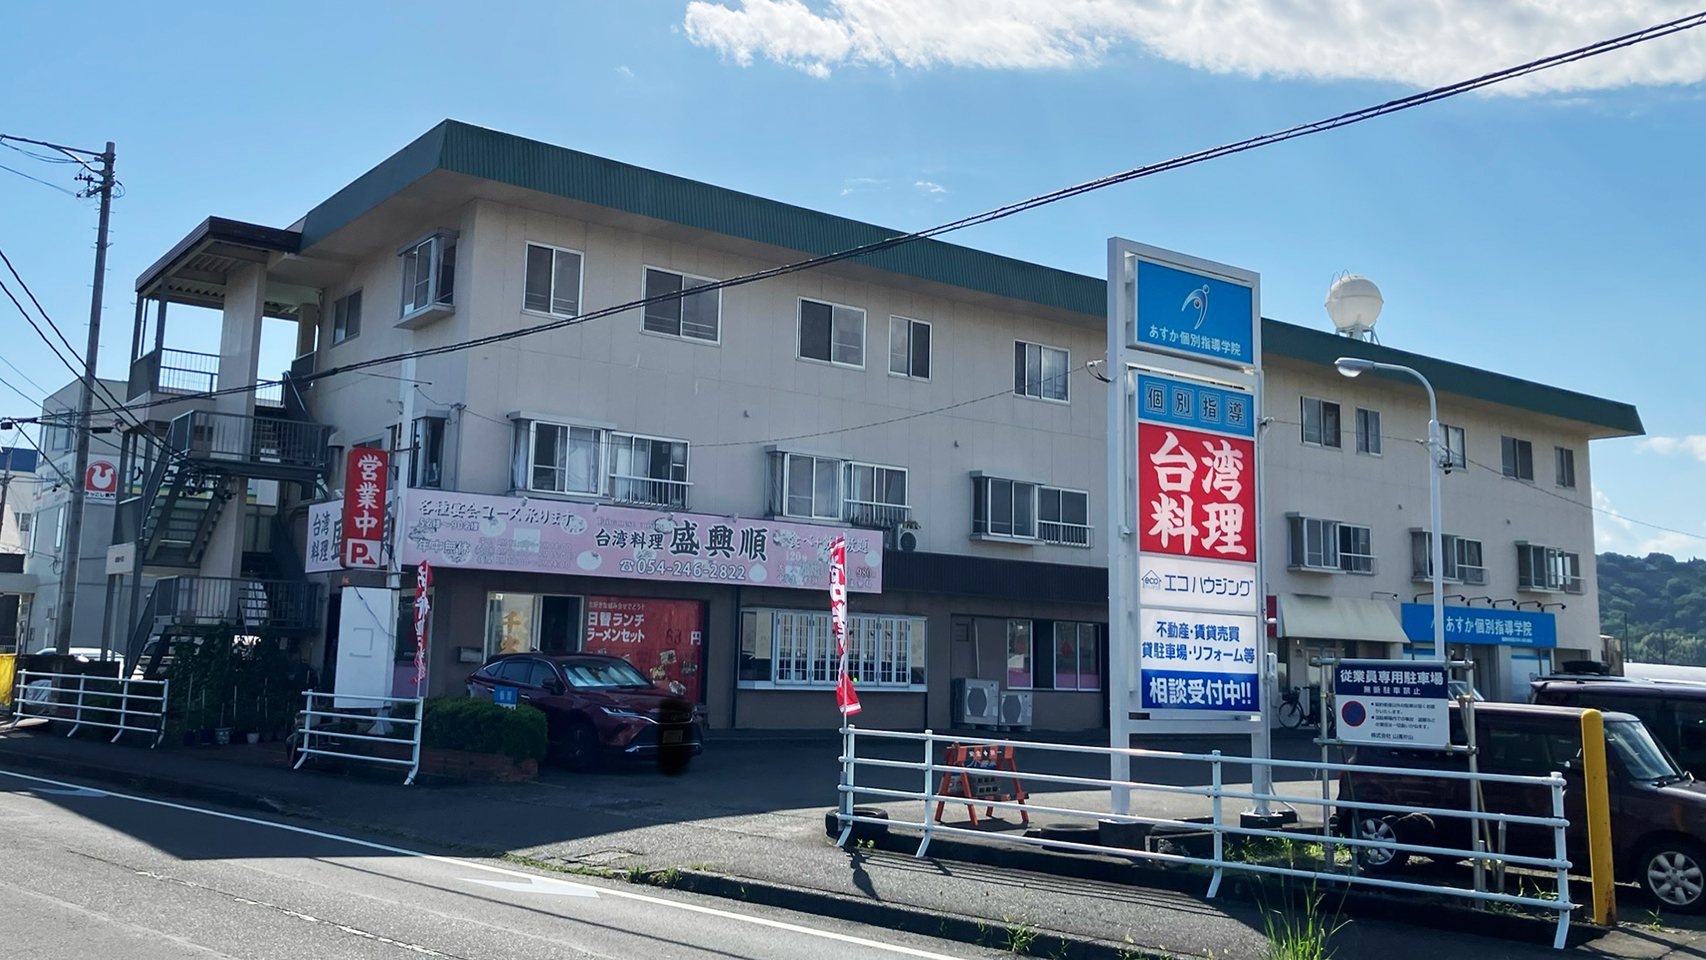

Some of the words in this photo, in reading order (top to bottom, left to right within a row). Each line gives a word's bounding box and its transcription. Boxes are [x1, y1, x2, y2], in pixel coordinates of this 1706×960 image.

[1149, 324, 1241, 356] あすか個別指導学院
[1149, 388, 1243, 422] 個別指導
[1150, 431, 1244, 501] 台湾
[353, 453, 383, 537] 営業中
[1149, 492, 1248, 555] 料理
[416, 538, 471, 554] 年中無休
[595, 528, 665, 550] 台湾料理
[670, 519, 769, 561] 盛興順
[351, 542, 368, 563] P
[637, 558, 746, 581] 054-246-2822
[588, 611, 645, 627] 日替ランチ
[1446, 616, 1532, 637] あすか個別指導学院
[587, 627, 645, 643] ラーメンセット
[690, 631, 701, 646] 円
[1156, 621, 1240, 642] 不動産・賃貸売買
[1142, 641, 1255, 664] 貸駐車場・リフォーム等
[1340, 669, 1444, 686] 従業員専用駐車場
